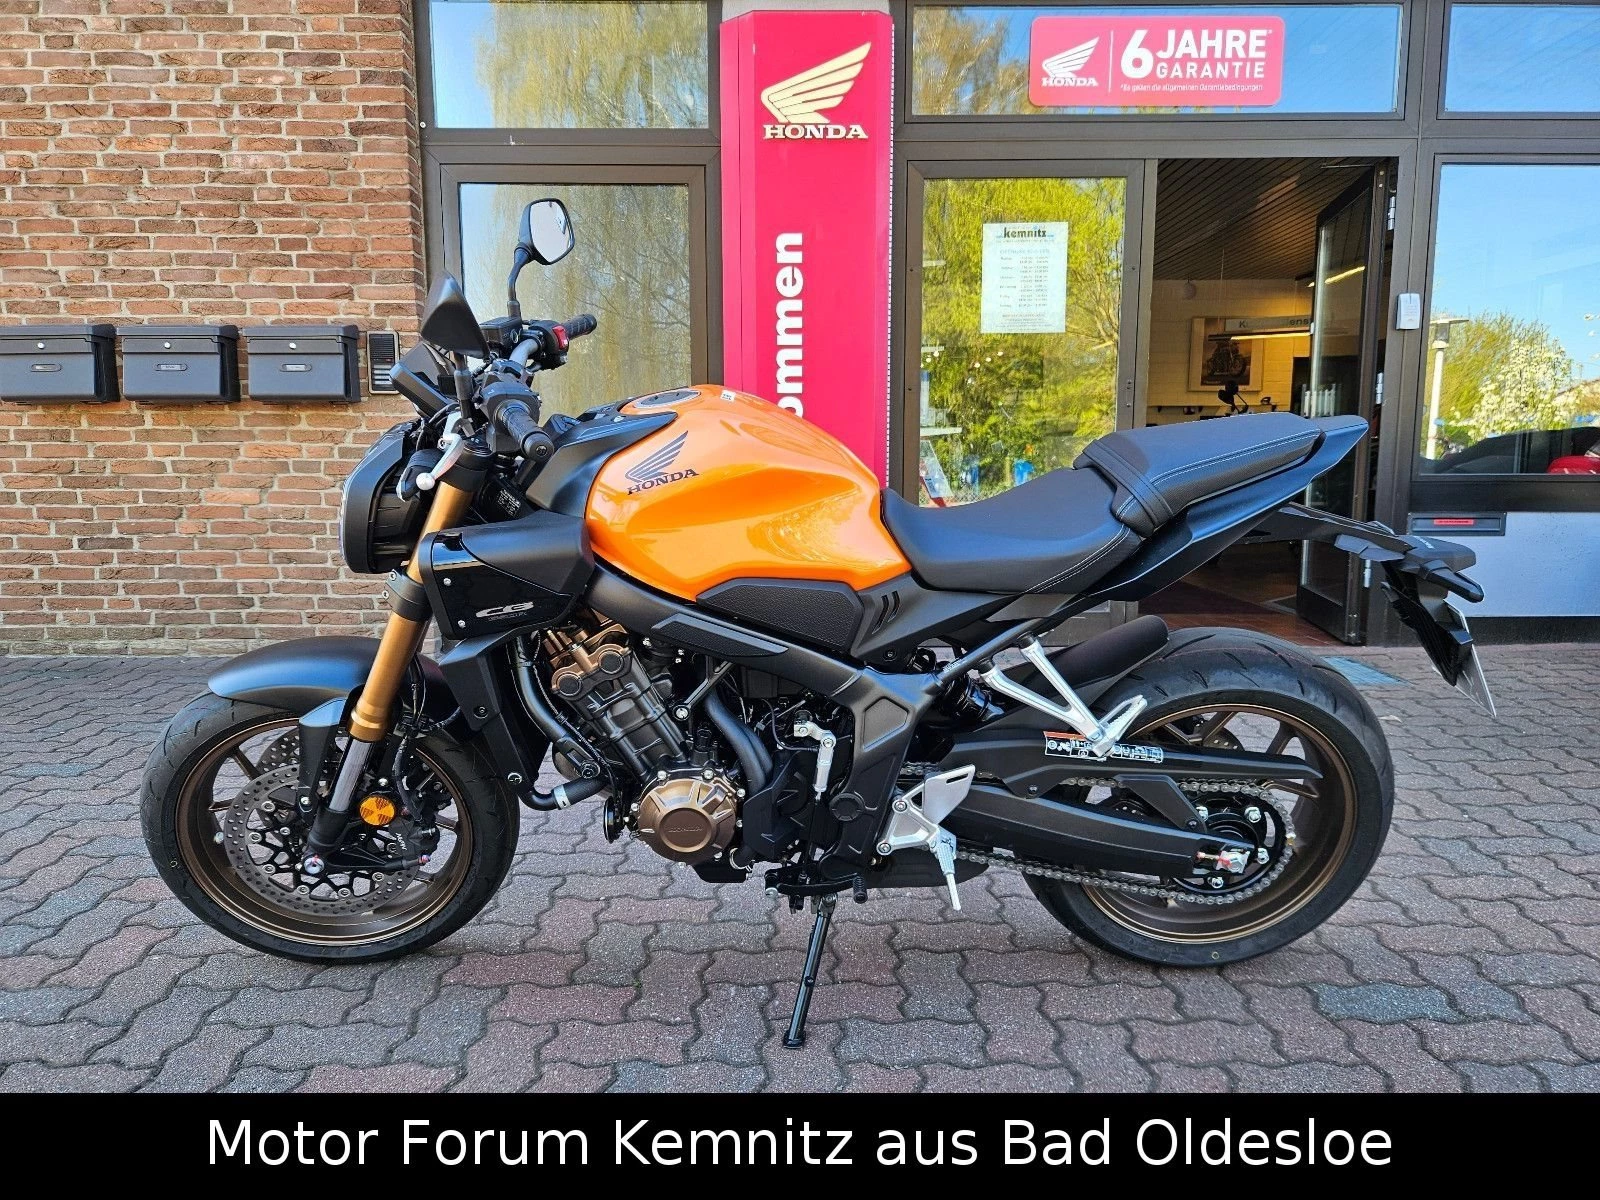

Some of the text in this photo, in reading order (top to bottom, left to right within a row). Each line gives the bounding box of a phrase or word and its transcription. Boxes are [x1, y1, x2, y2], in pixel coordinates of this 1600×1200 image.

[1120, 29, 1154, 79] 6
[1155, 61, 1265, 79] GARANTIE
[1041, 76, 1100, 88] HONDA
[763, 124, 869, 140] HONDA
[1003, 227, 1047, 238] kemnitz
[627, 468, 699, 496] HONDA
[475, 601, 534, 618] CB
